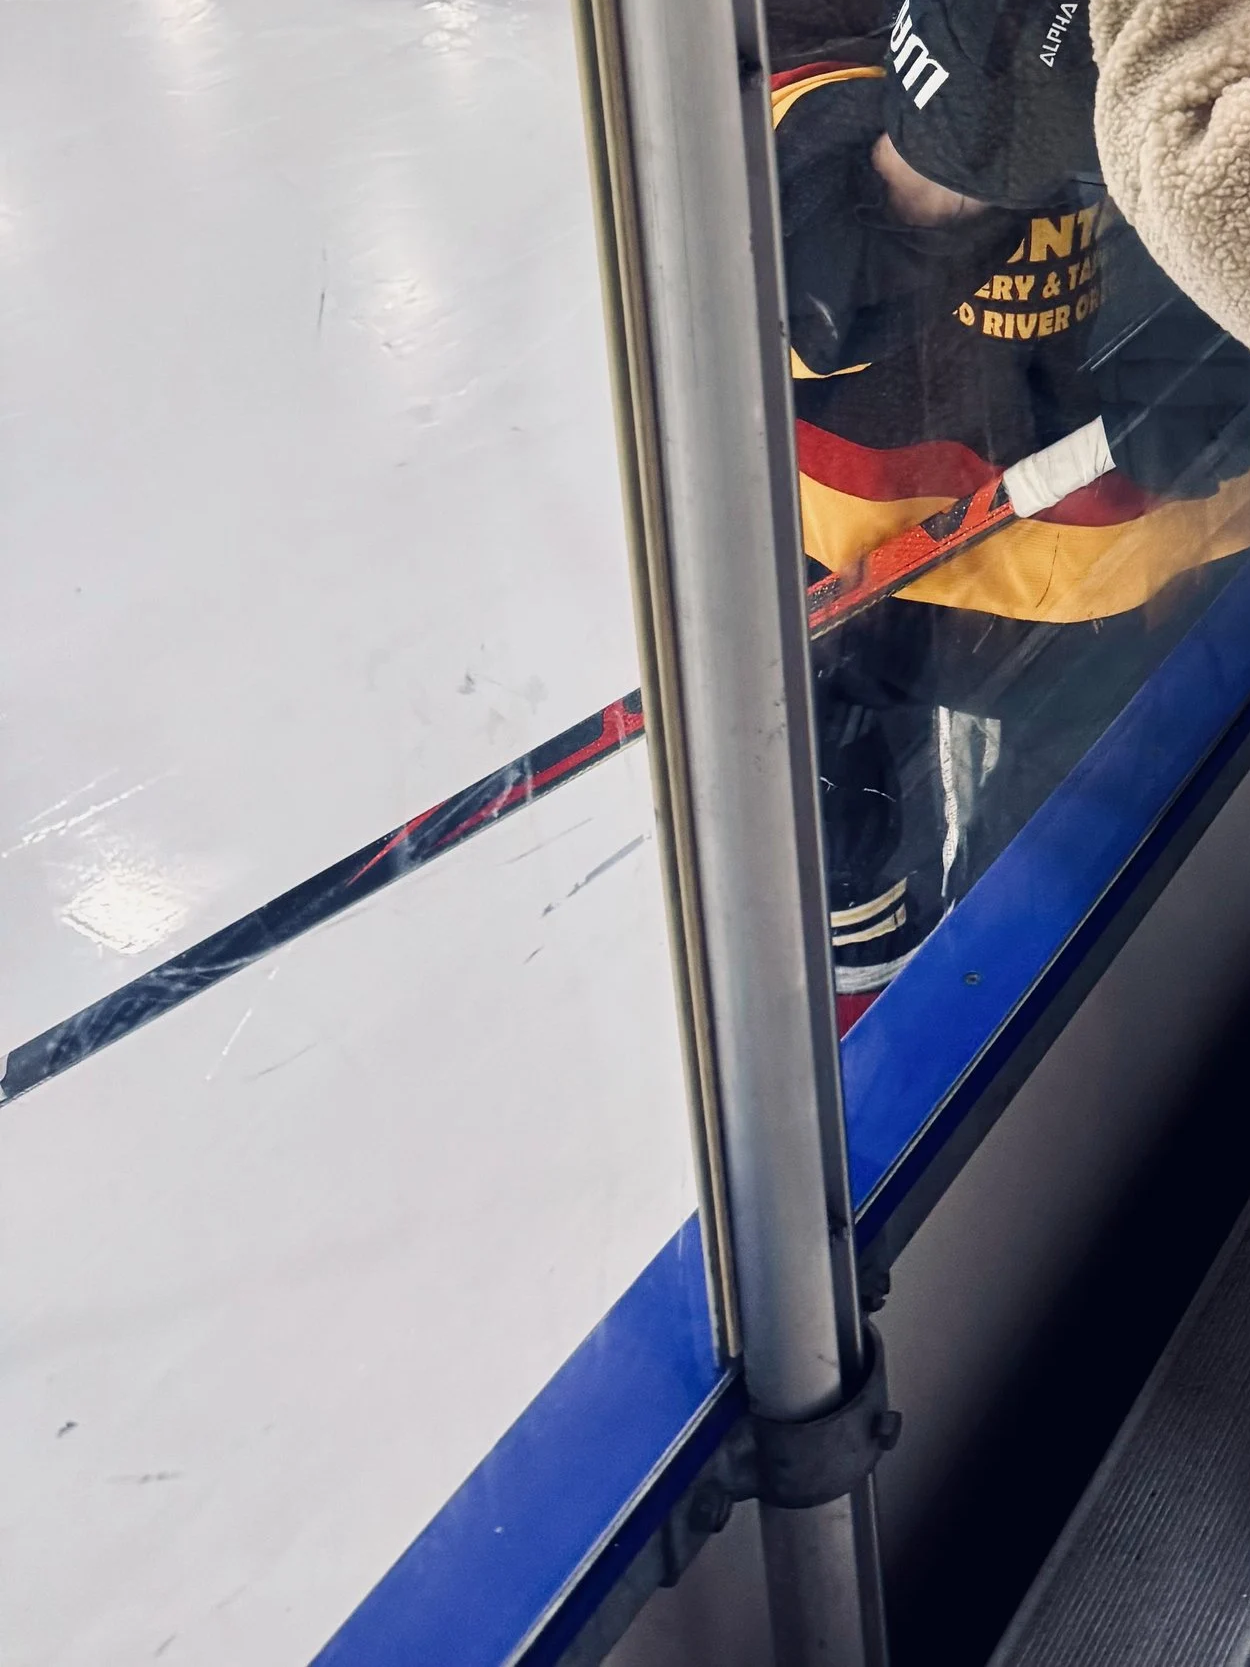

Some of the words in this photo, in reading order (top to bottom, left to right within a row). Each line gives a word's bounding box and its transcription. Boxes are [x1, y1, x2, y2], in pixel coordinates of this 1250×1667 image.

[1039, 3, 1078, 68] ALPHA
[1006, 202, 1101, 263] NT
[1042, 271, 1061, 299] &
[982, 304, 1071, 340] RIVER
